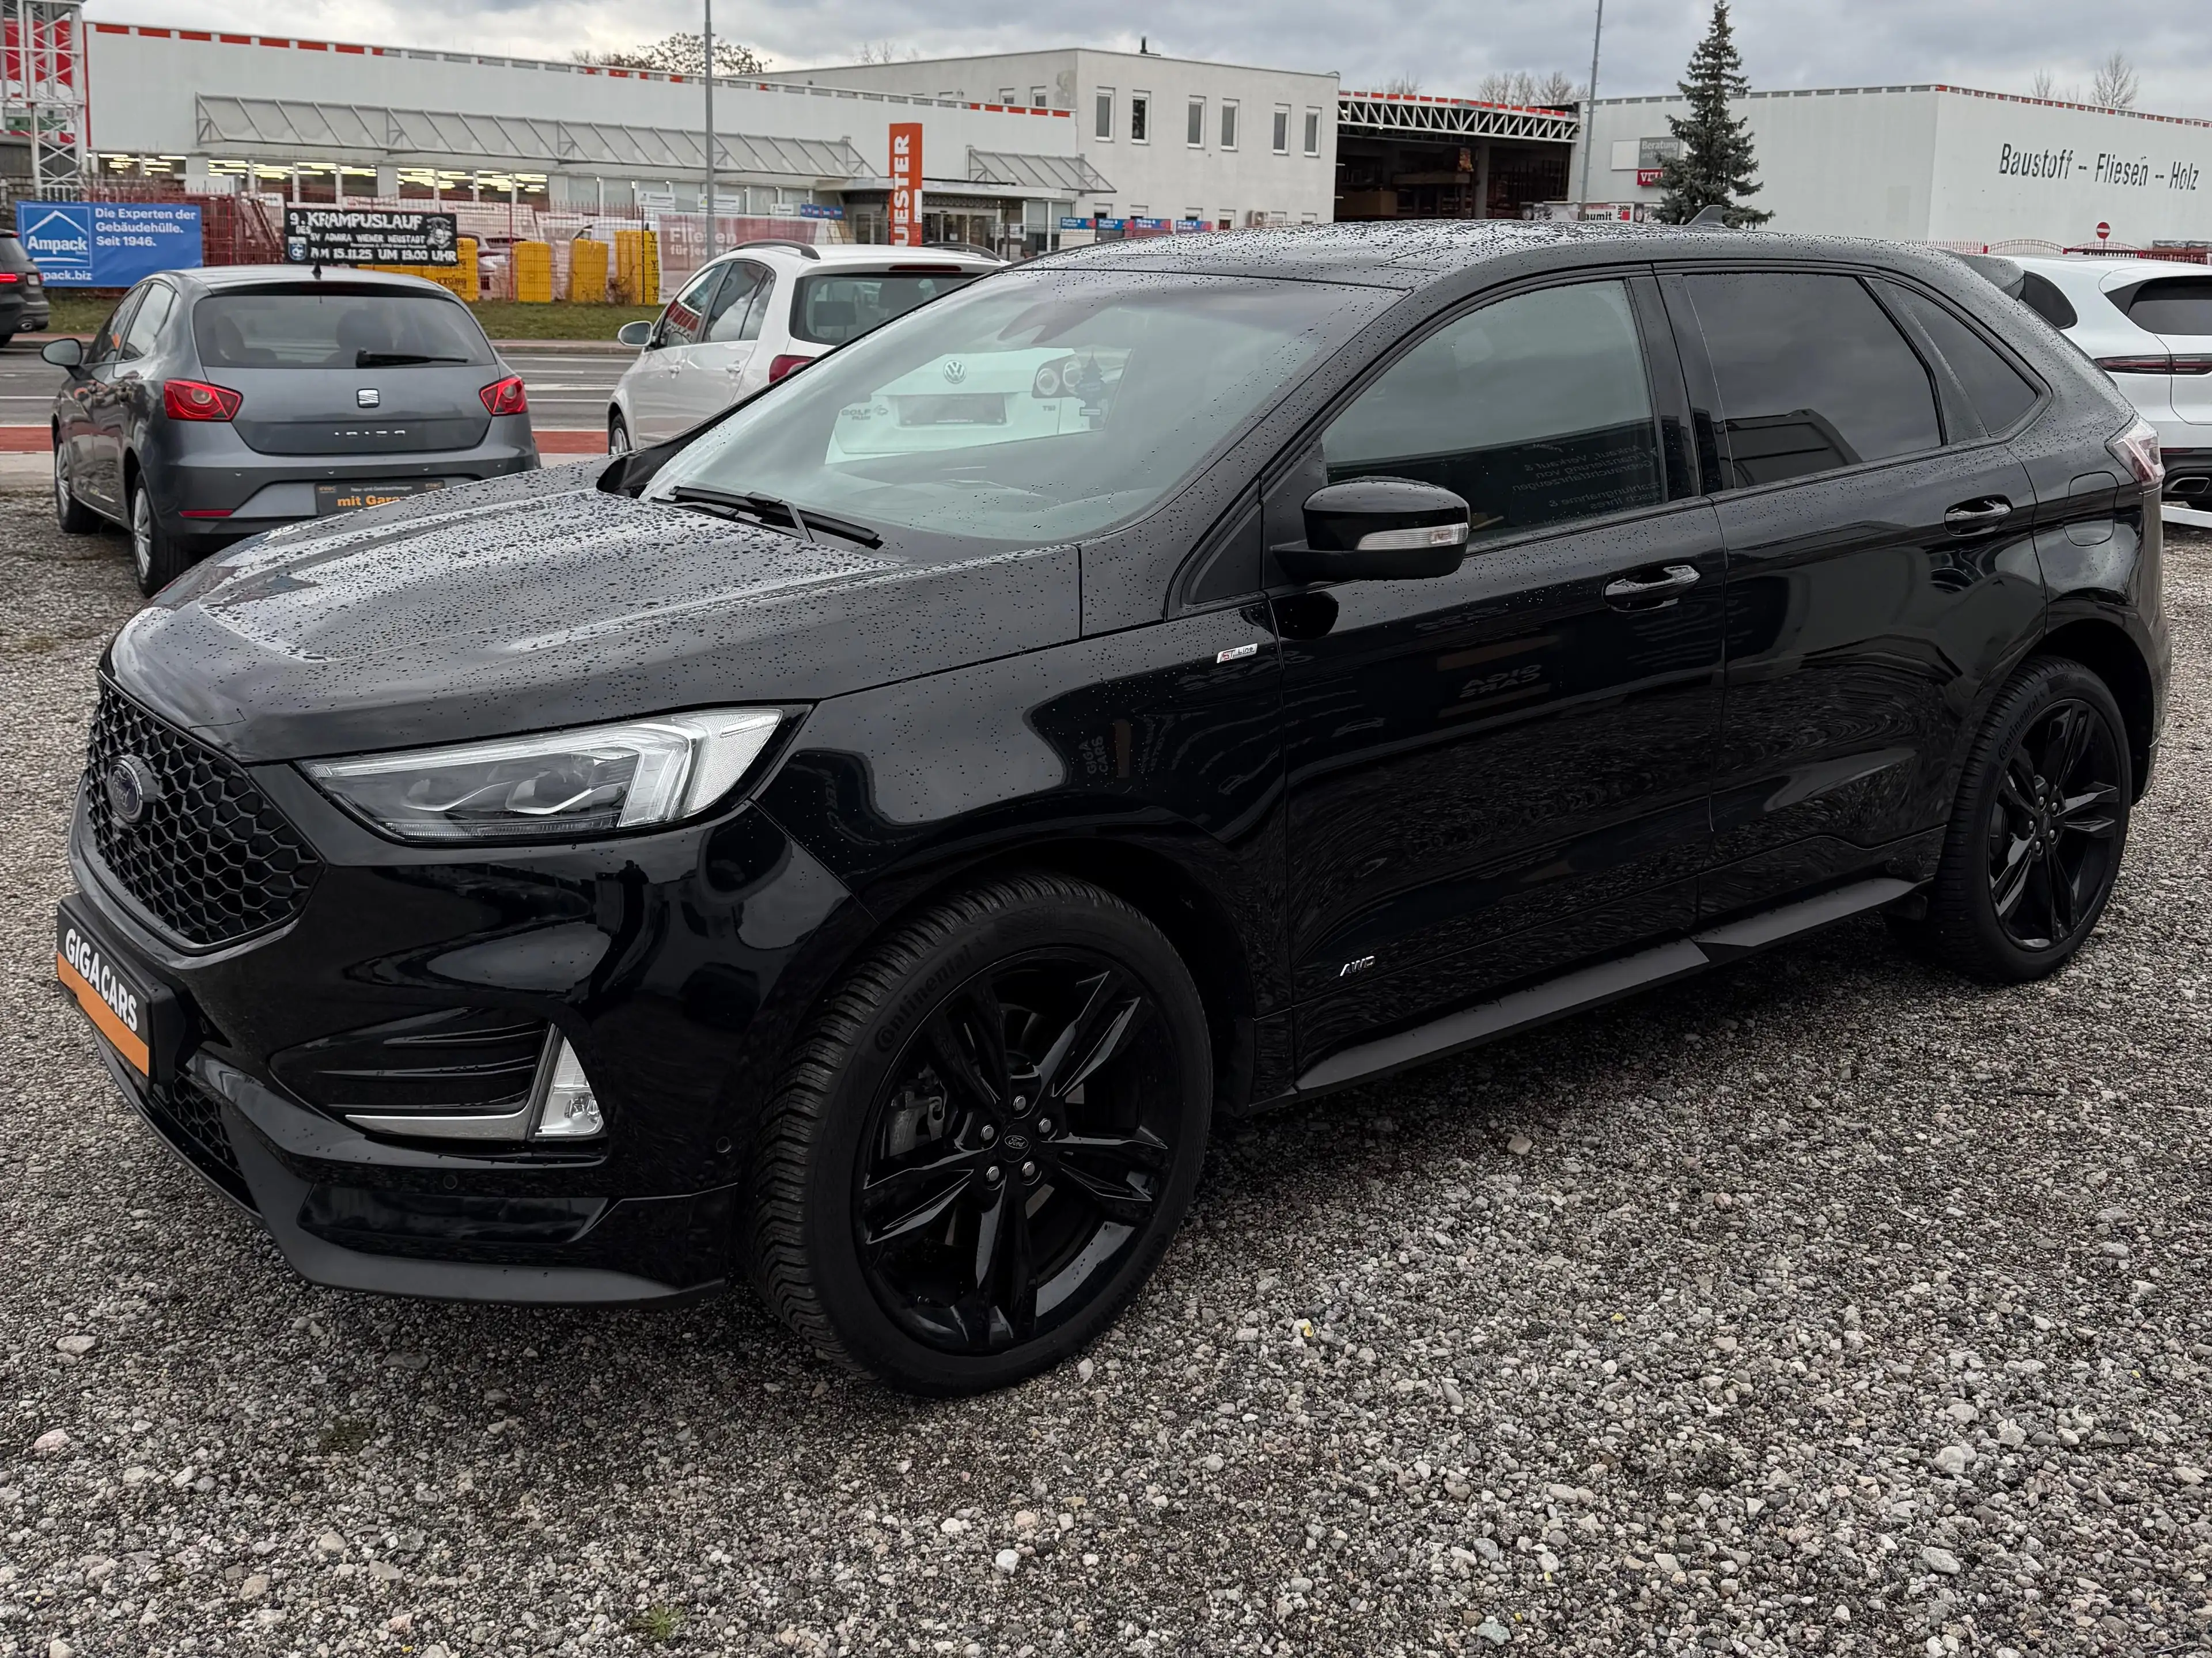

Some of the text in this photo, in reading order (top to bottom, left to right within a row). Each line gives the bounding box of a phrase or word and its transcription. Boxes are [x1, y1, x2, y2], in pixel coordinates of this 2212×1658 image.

[1642, 141, 1679, 151] Beratung
[1999, 143, 2074, 180] Baustoff
[2094, 153, 2149, 187] Fliesen
[2169, 161, 2199, 191] Holz
[894, 134, 910, 246] UESTER
[95, 208, 196, 221] Die Experten der
[1578, 211, 1612, 221] aumit
[95, 222, 184, 234] Gebäudehülle.
[310, 233, 426, 244] SV ADMIRA WIENER NEUSTADT
[669, 226, 737, 244] Flieen
[27, 236, 88, 255] Ampack
[96, 236, 157, 247] Seit 1946.
[310, 248, 329, 259] AM
[333, 248, 373, 260] 15.11.25
[377, 248, 398, 260] UM
[401, 249, 428, 260] 19.00
[431, 250, 457, 262] UHR
[670, 244, 688, 255] für
[43, 270, 93, 282] pack.biz
[337, 495, 362, 507] mit
[1339, 955, 1376, 977] AWD
[874, 944, 972, 1052] Continental
[1008, 1136, 1025, 1147] Ford
